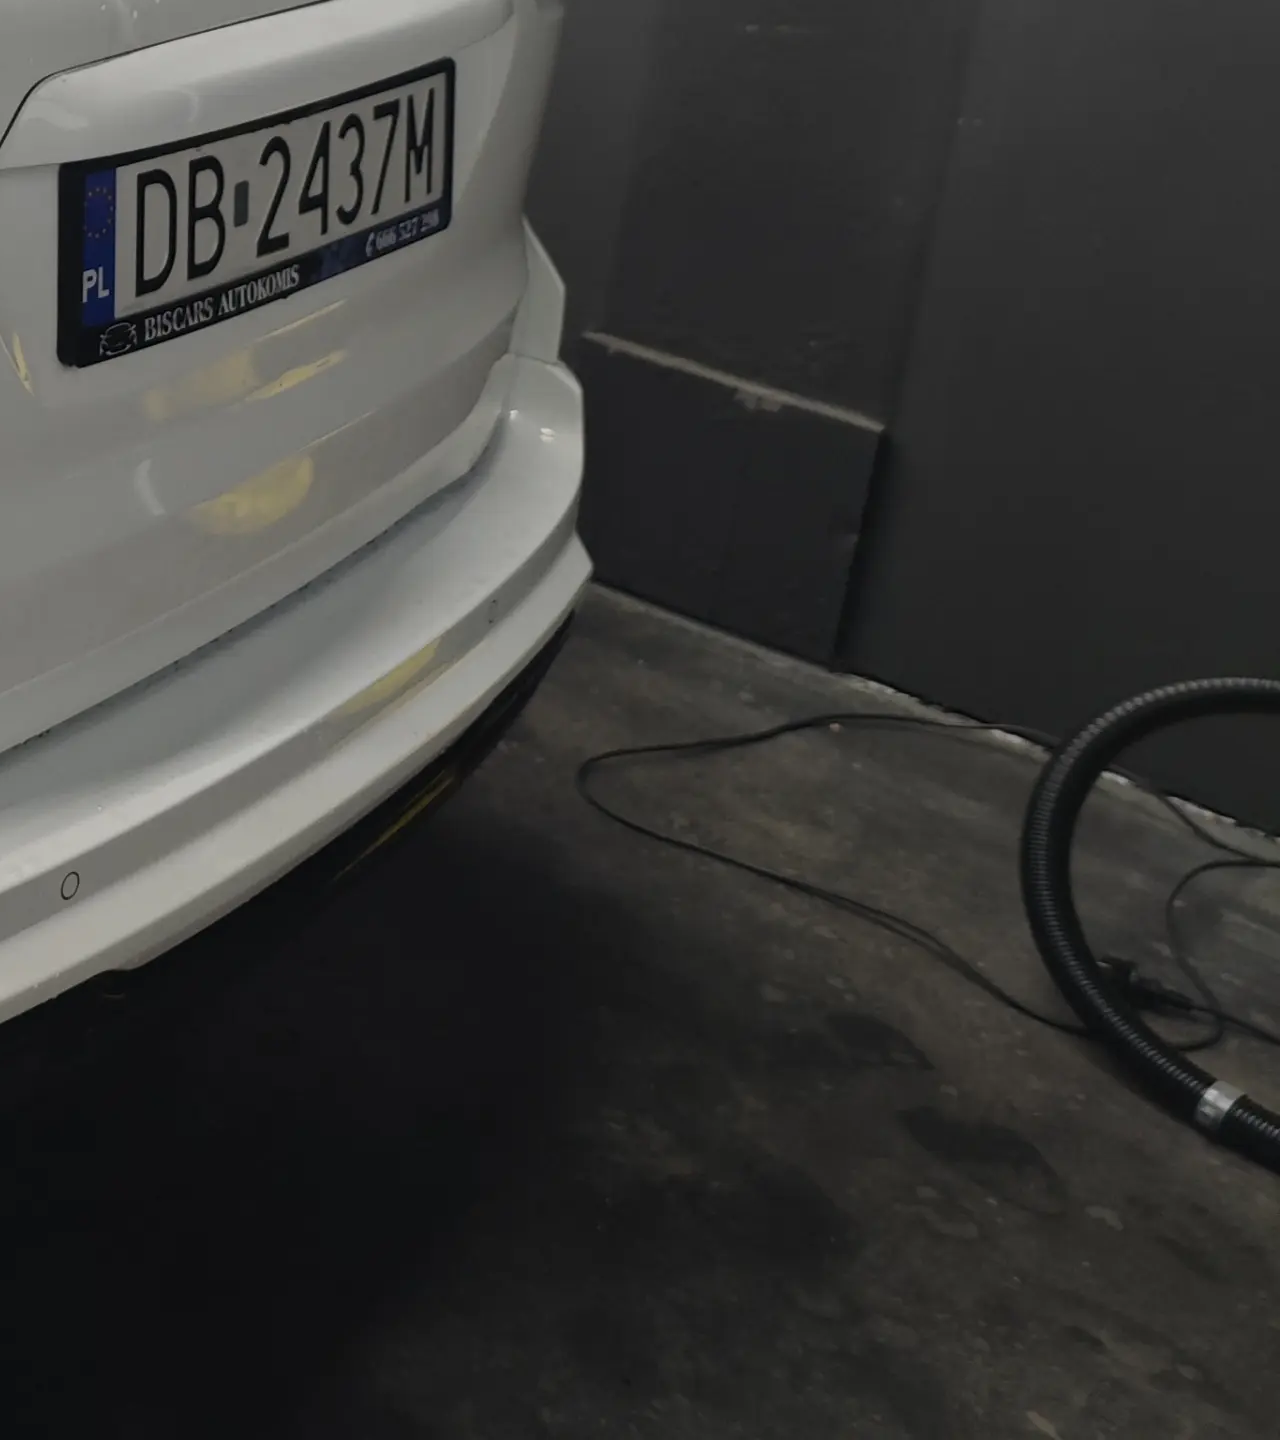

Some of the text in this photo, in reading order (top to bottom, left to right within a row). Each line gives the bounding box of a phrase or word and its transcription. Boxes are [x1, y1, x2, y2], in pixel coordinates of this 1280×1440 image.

[135, 87, 436, 298] DB 2437M
[81, 268, 110, 304] PL
[144, 264, 301, 342] BISCARS AUTOKOMIS
